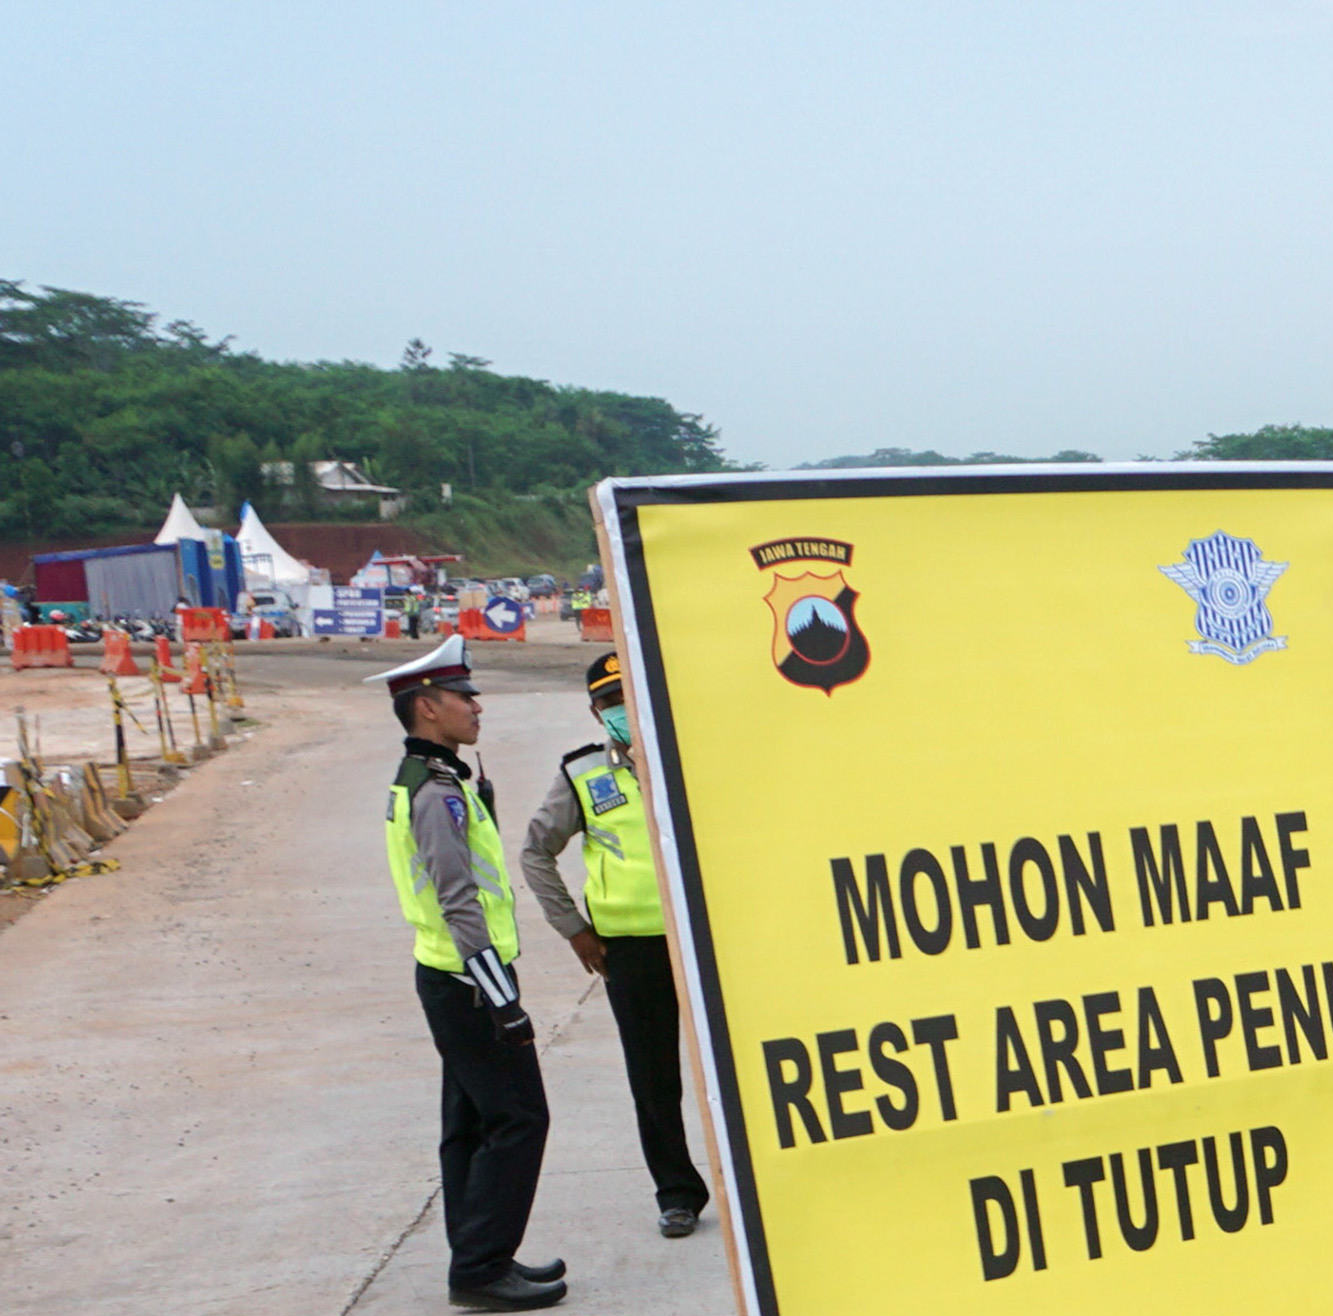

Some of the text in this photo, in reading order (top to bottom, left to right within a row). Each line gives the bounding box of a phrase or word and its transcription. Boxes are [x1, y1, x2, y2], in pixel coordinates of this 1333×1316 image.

[759, 541, 847, 564] JAWA TENGAH
[831, 811, 1311, 965] MOHON MAAF
[761, 1014, 959, 1149] REST
[996, 986, 1184, 1113] AREA
[969, 1125, 1288, 1282] DI TUTUP
